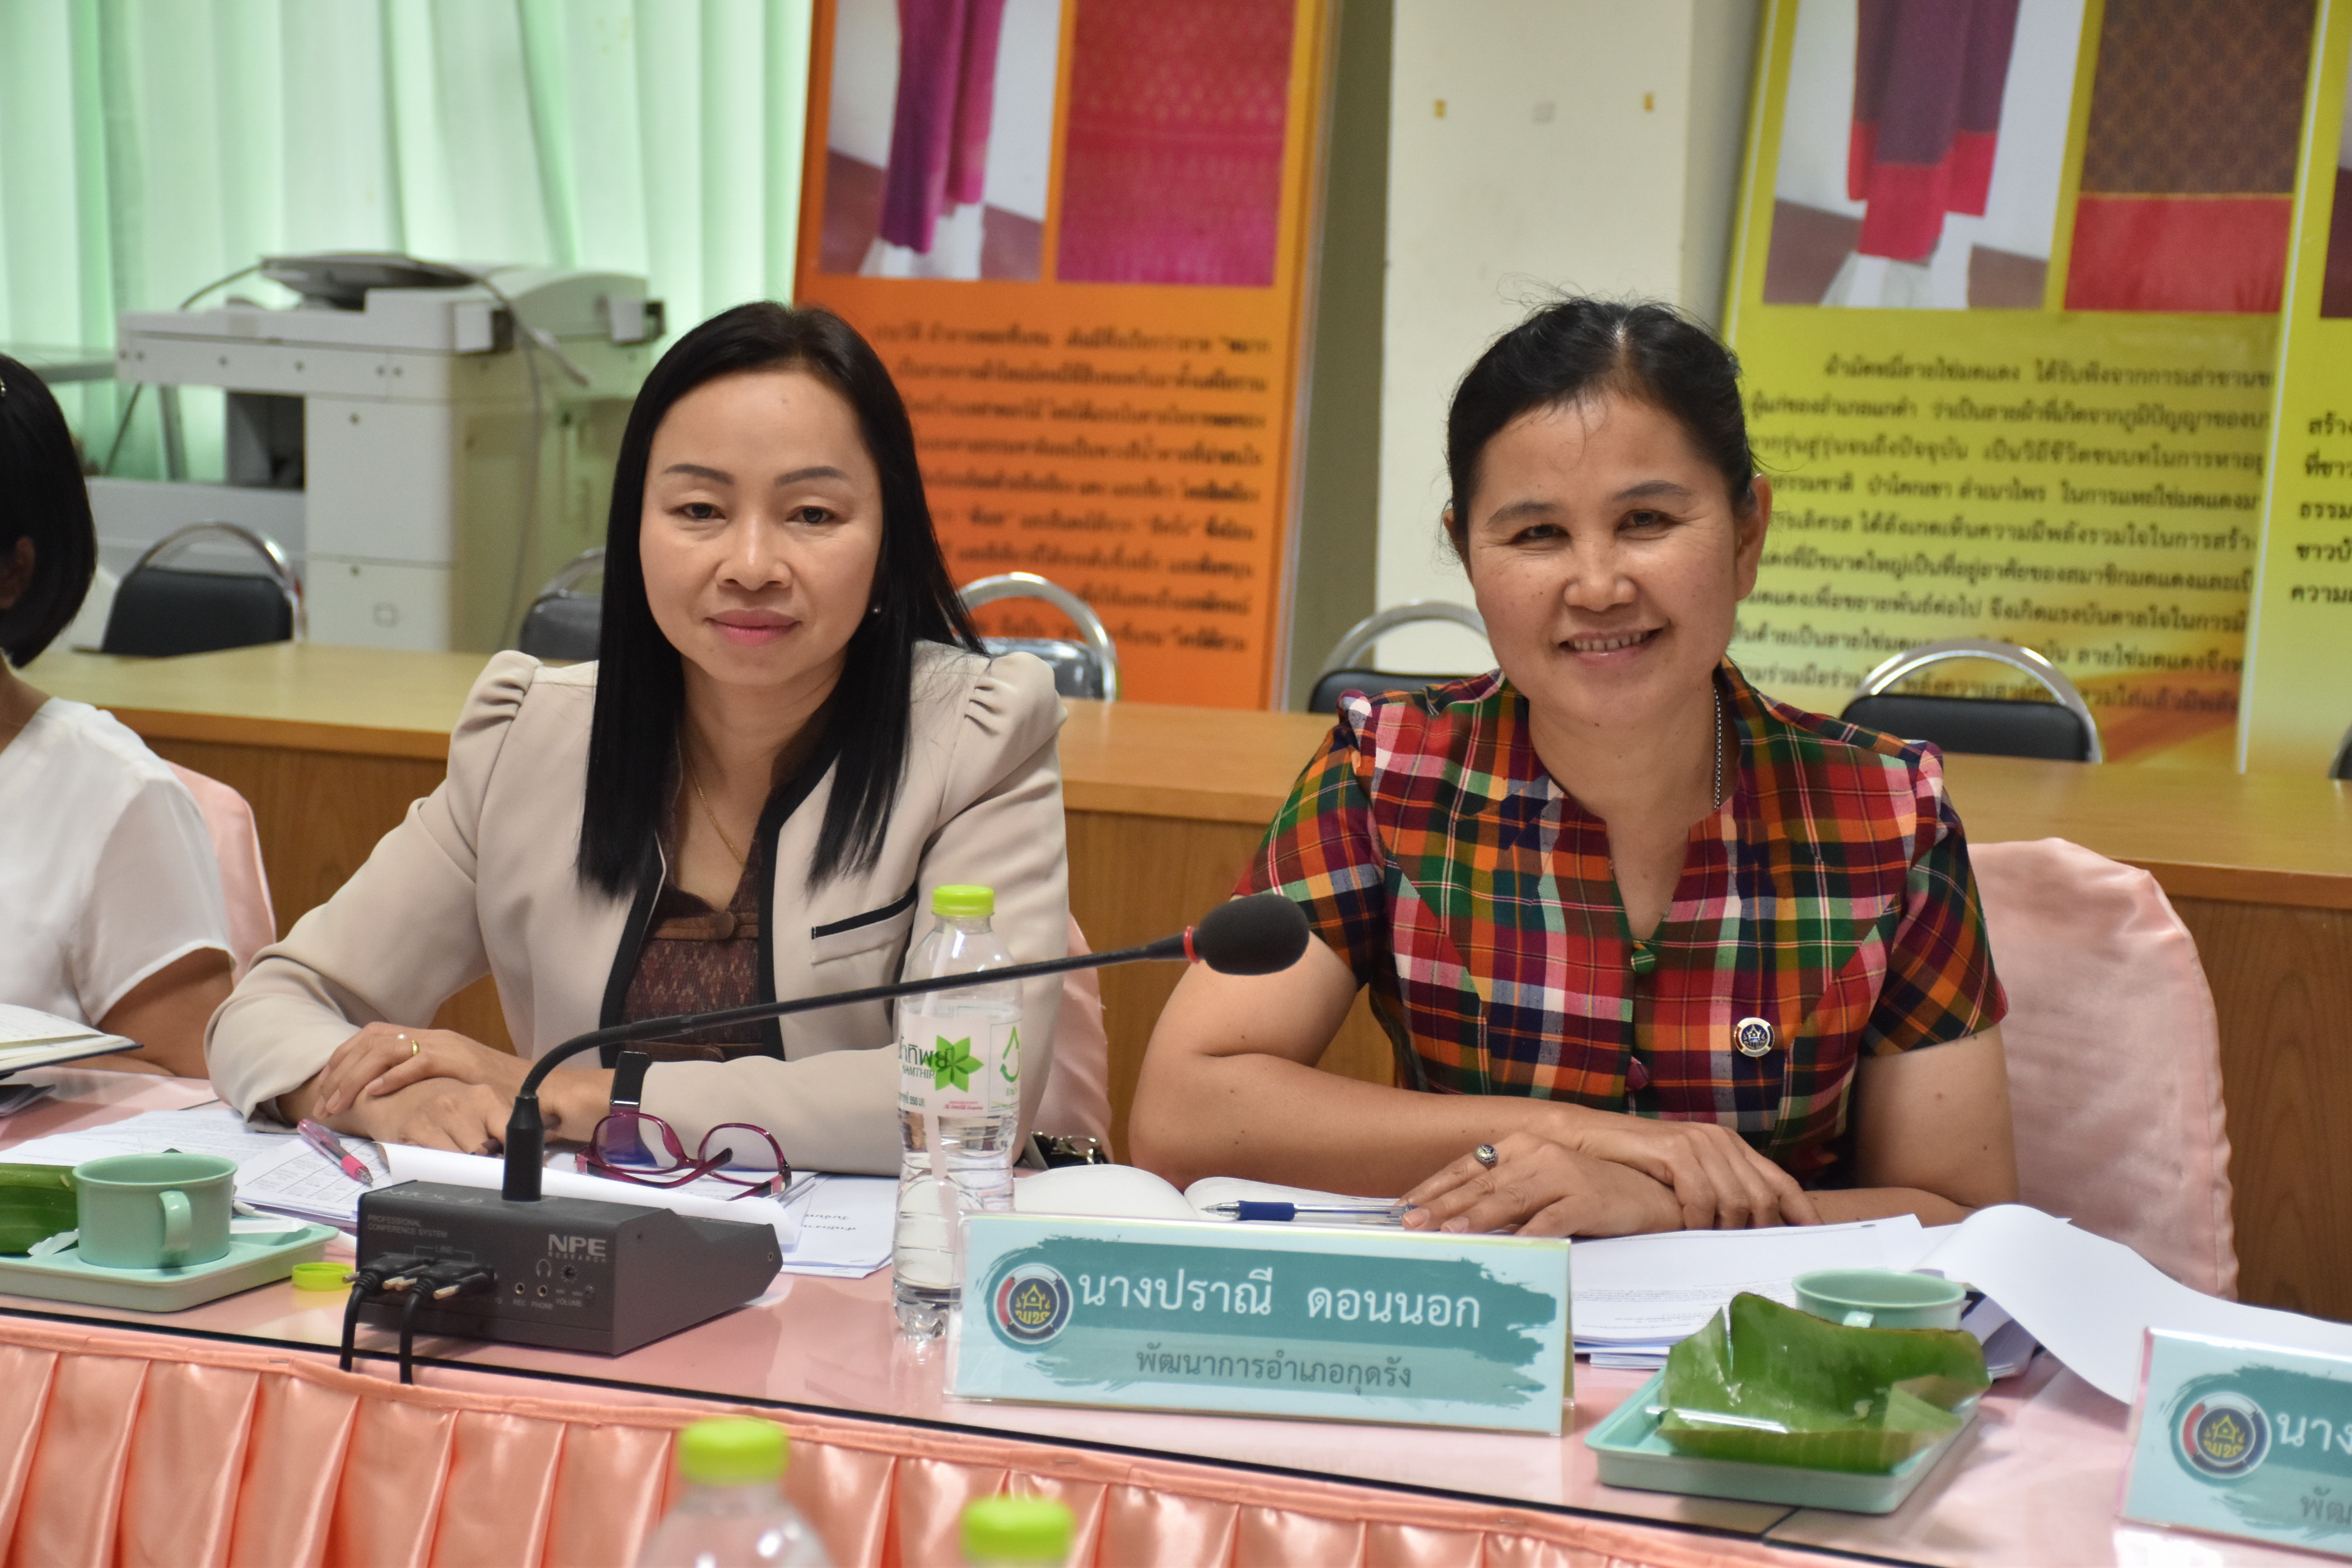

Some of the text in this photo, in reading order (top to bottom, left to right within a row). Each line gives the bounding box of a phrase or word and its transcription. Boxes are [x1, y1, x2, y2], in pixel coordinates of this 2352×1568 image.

[2292, 585, 2352, 604] ความ
[367, 1214, 421, 1226] PROFESSIONAL
[367, 1224, 447, 1238] CONFERENCE SYSTEM
[435, 1245, 454, 1254] LINE
[548, 1234, 607, 1258] NPE
[548, 1252, 606, 1264] RESEARCH
[555, 1298, 582, 1308] VOLUME
[1079, 1267, 1481, 1329] นางปราณี ดอนนอก
[531, 1301, 554, 1310] PHONE
[1136, 1342, 1412, 1395] พัฒนาการอำเภอกุดรัง
